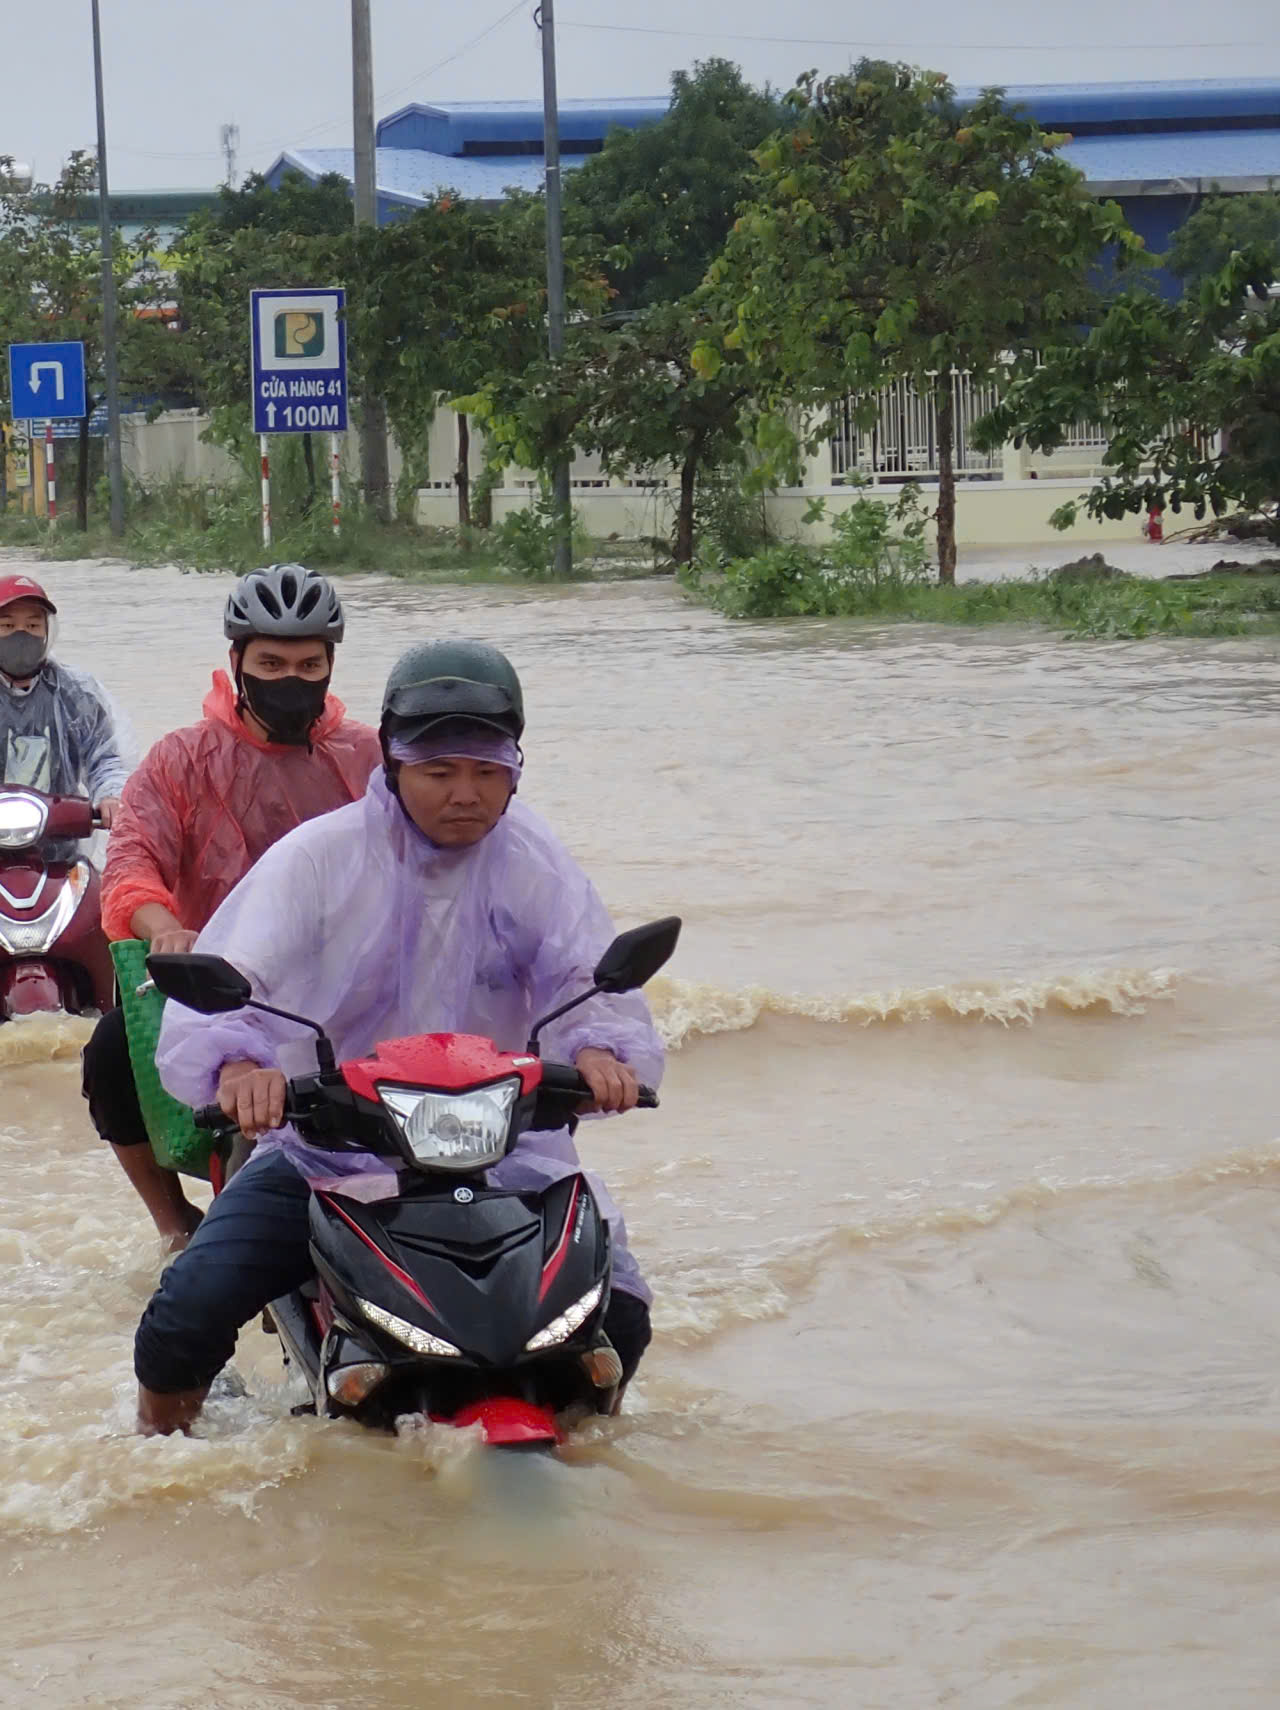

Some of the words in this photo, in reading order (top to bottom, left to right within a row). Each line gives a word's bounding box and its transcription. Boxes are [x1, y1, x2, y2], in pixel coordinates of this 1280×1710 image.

[261, 376, 287, 398] CỬA
[289, 376, 325, 397] HÀNG
[327, 380, 341, 396] 41
[282, 404, 338, 427] 100M
